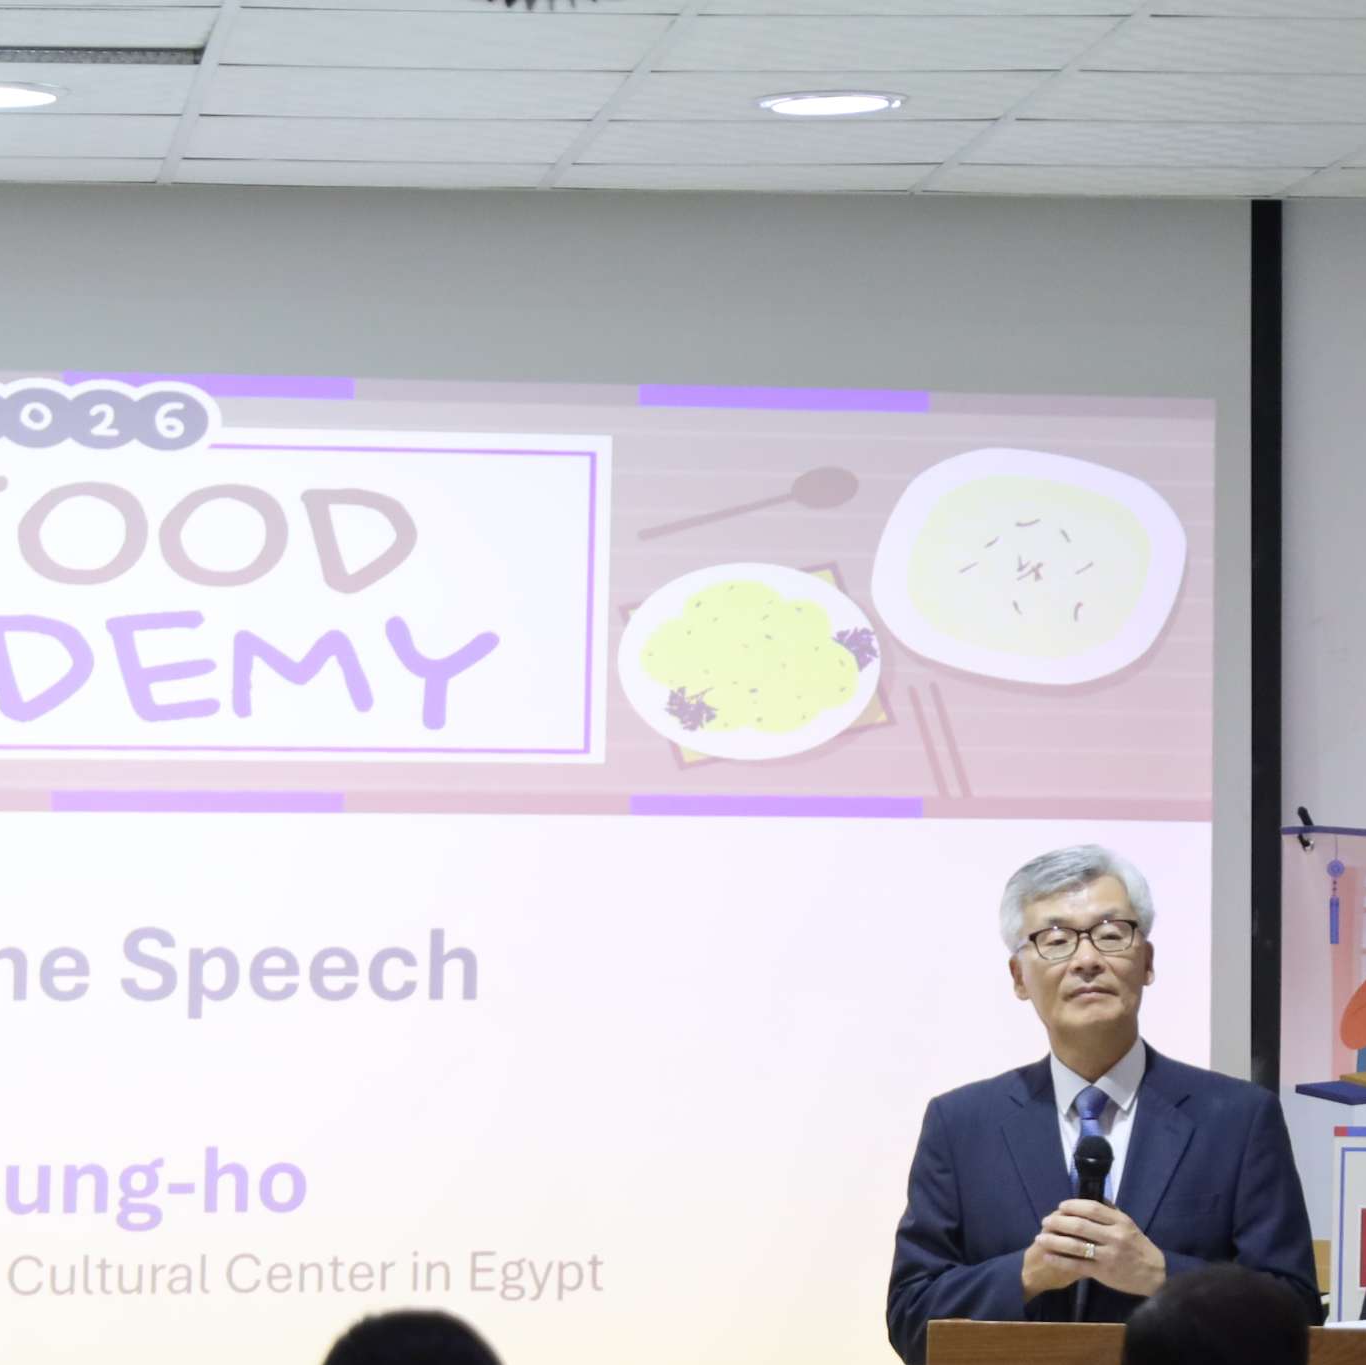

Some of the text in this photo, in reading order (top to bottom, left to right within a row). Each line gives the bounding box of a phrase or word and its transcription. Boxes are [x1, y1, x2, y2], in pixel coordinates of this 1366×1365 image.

[121, 926, 478, 1020] Speech
[6, 1253, 211, 1297] Cultural
[225, 1251, 395, 1295] Center
[411, 1250, 452, 1293] in
[469, 1250, 605, 1303] Egypt
